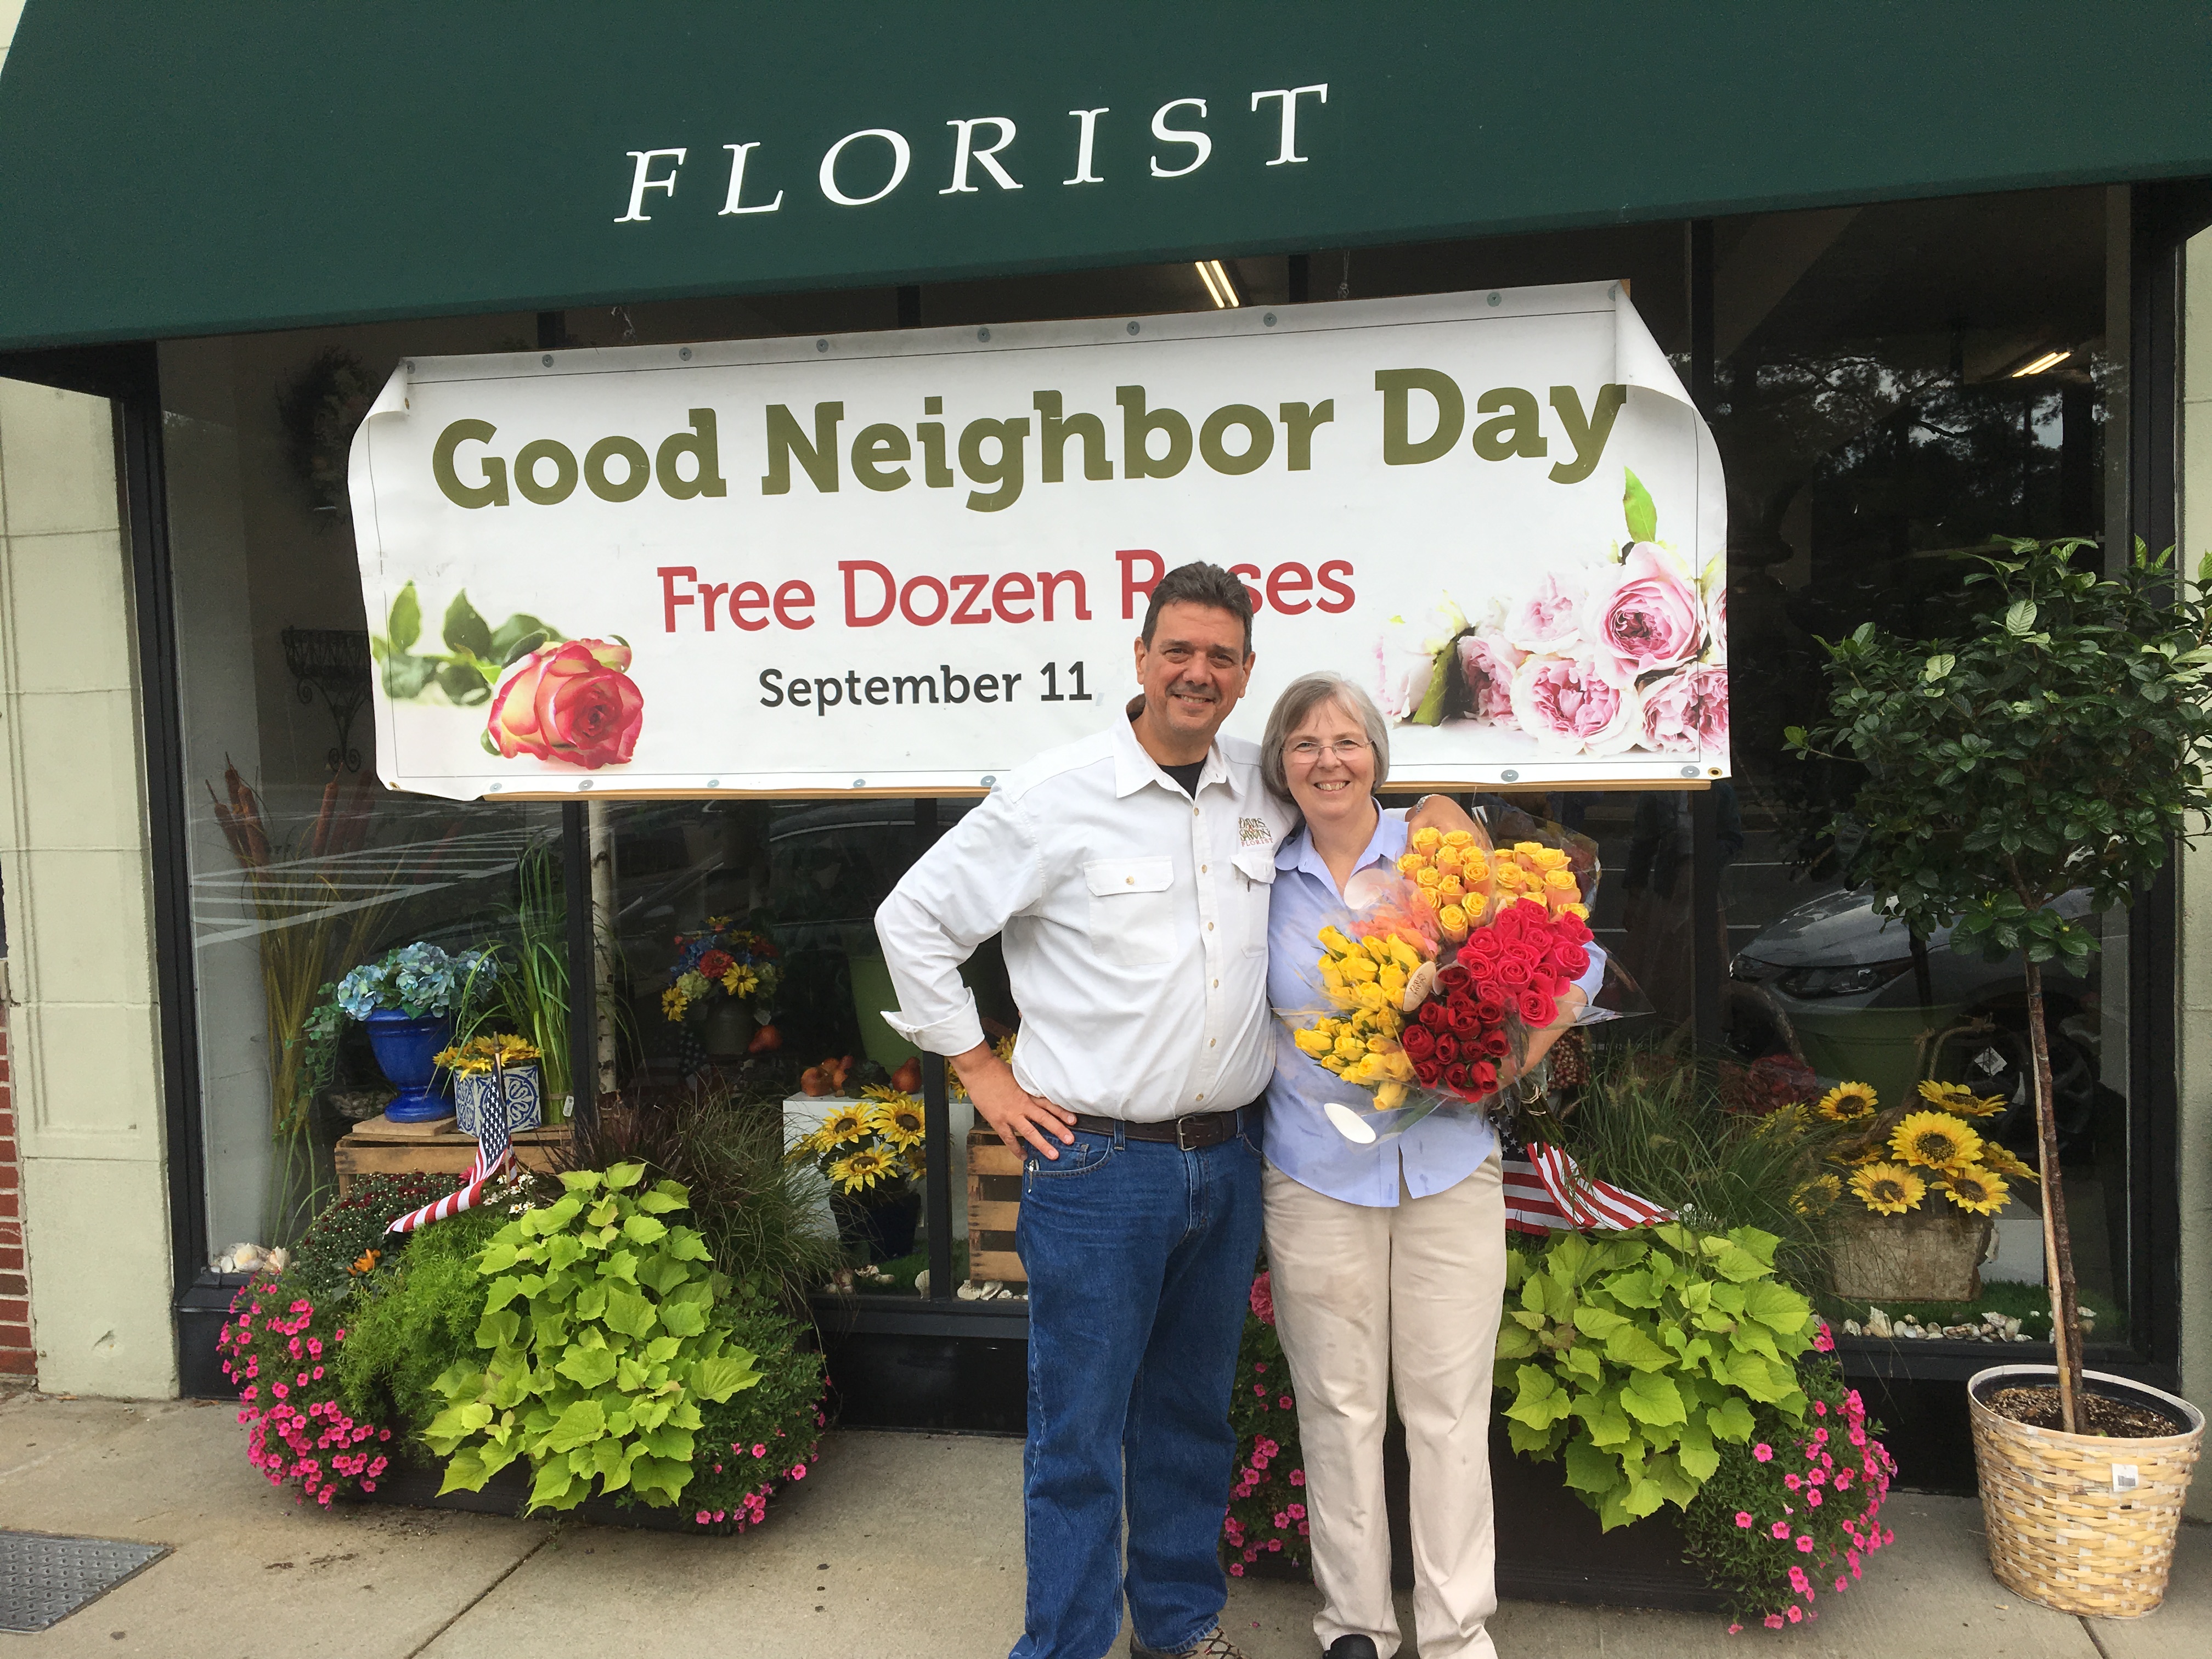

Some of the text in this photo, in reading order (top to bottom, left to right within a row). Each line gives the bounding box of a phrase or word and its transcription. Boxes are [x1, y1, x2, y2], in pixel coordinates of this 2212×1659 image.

[613, 83, 1328, 222] FLORIST
[432, 368, 1627, 512] Good Neighbor Day
[657, 549, 1356, 633] Free Dozen Rses
[759, 661, 1092, 716] September 11
[1239, 817, 1267, 828] DAVIS
[1241, 838, 1273, 847] FLORIST
